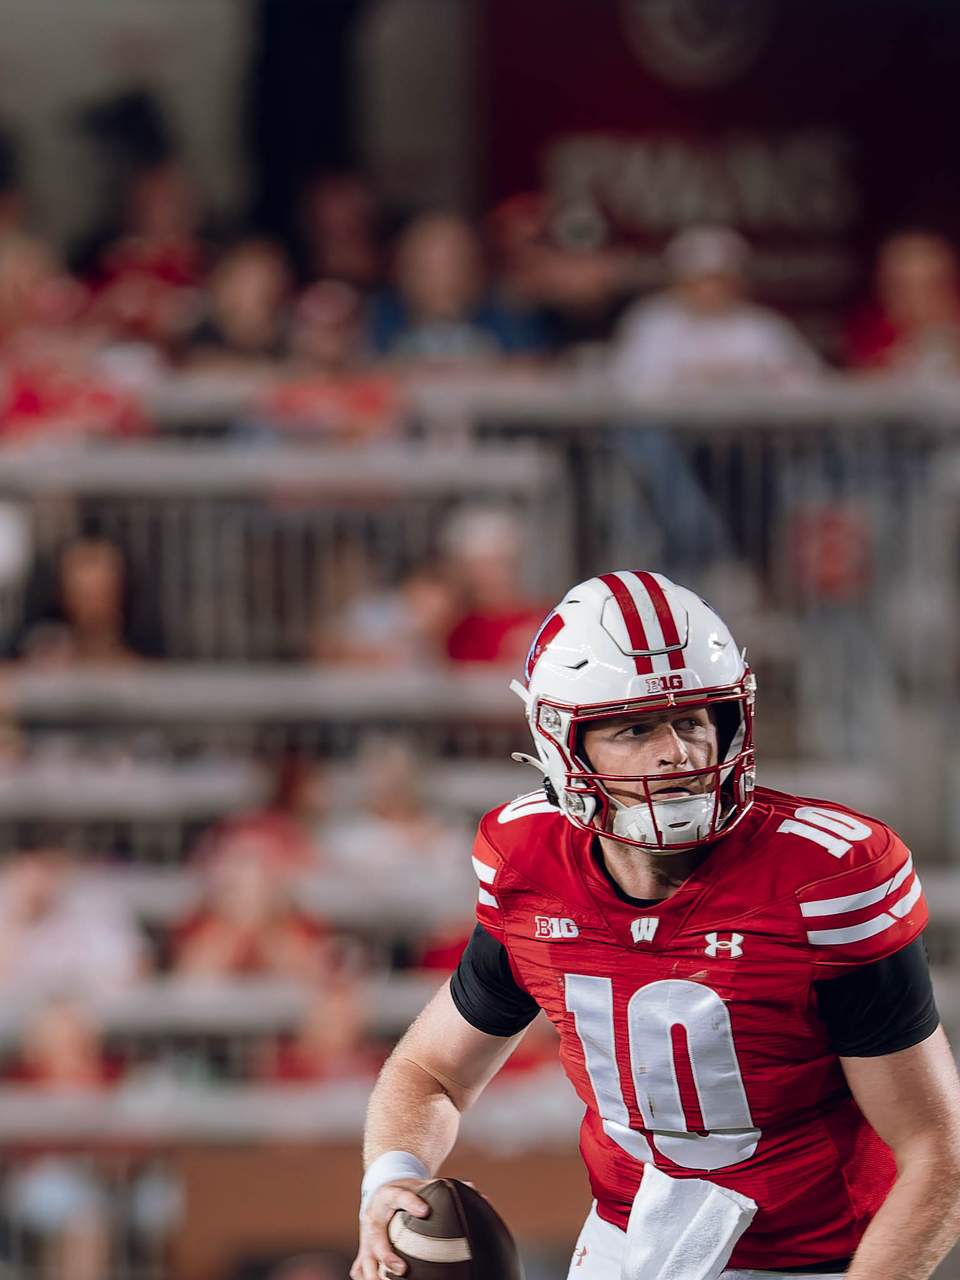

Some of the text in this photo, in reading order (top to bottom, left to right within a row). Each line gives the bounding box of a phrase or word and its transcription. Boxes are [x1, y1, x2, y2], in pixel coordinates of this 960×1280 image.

[776, 806, 873, 859] 10
[630, 917, 660, 944] W
[564, 973, 762, 1172] 10
